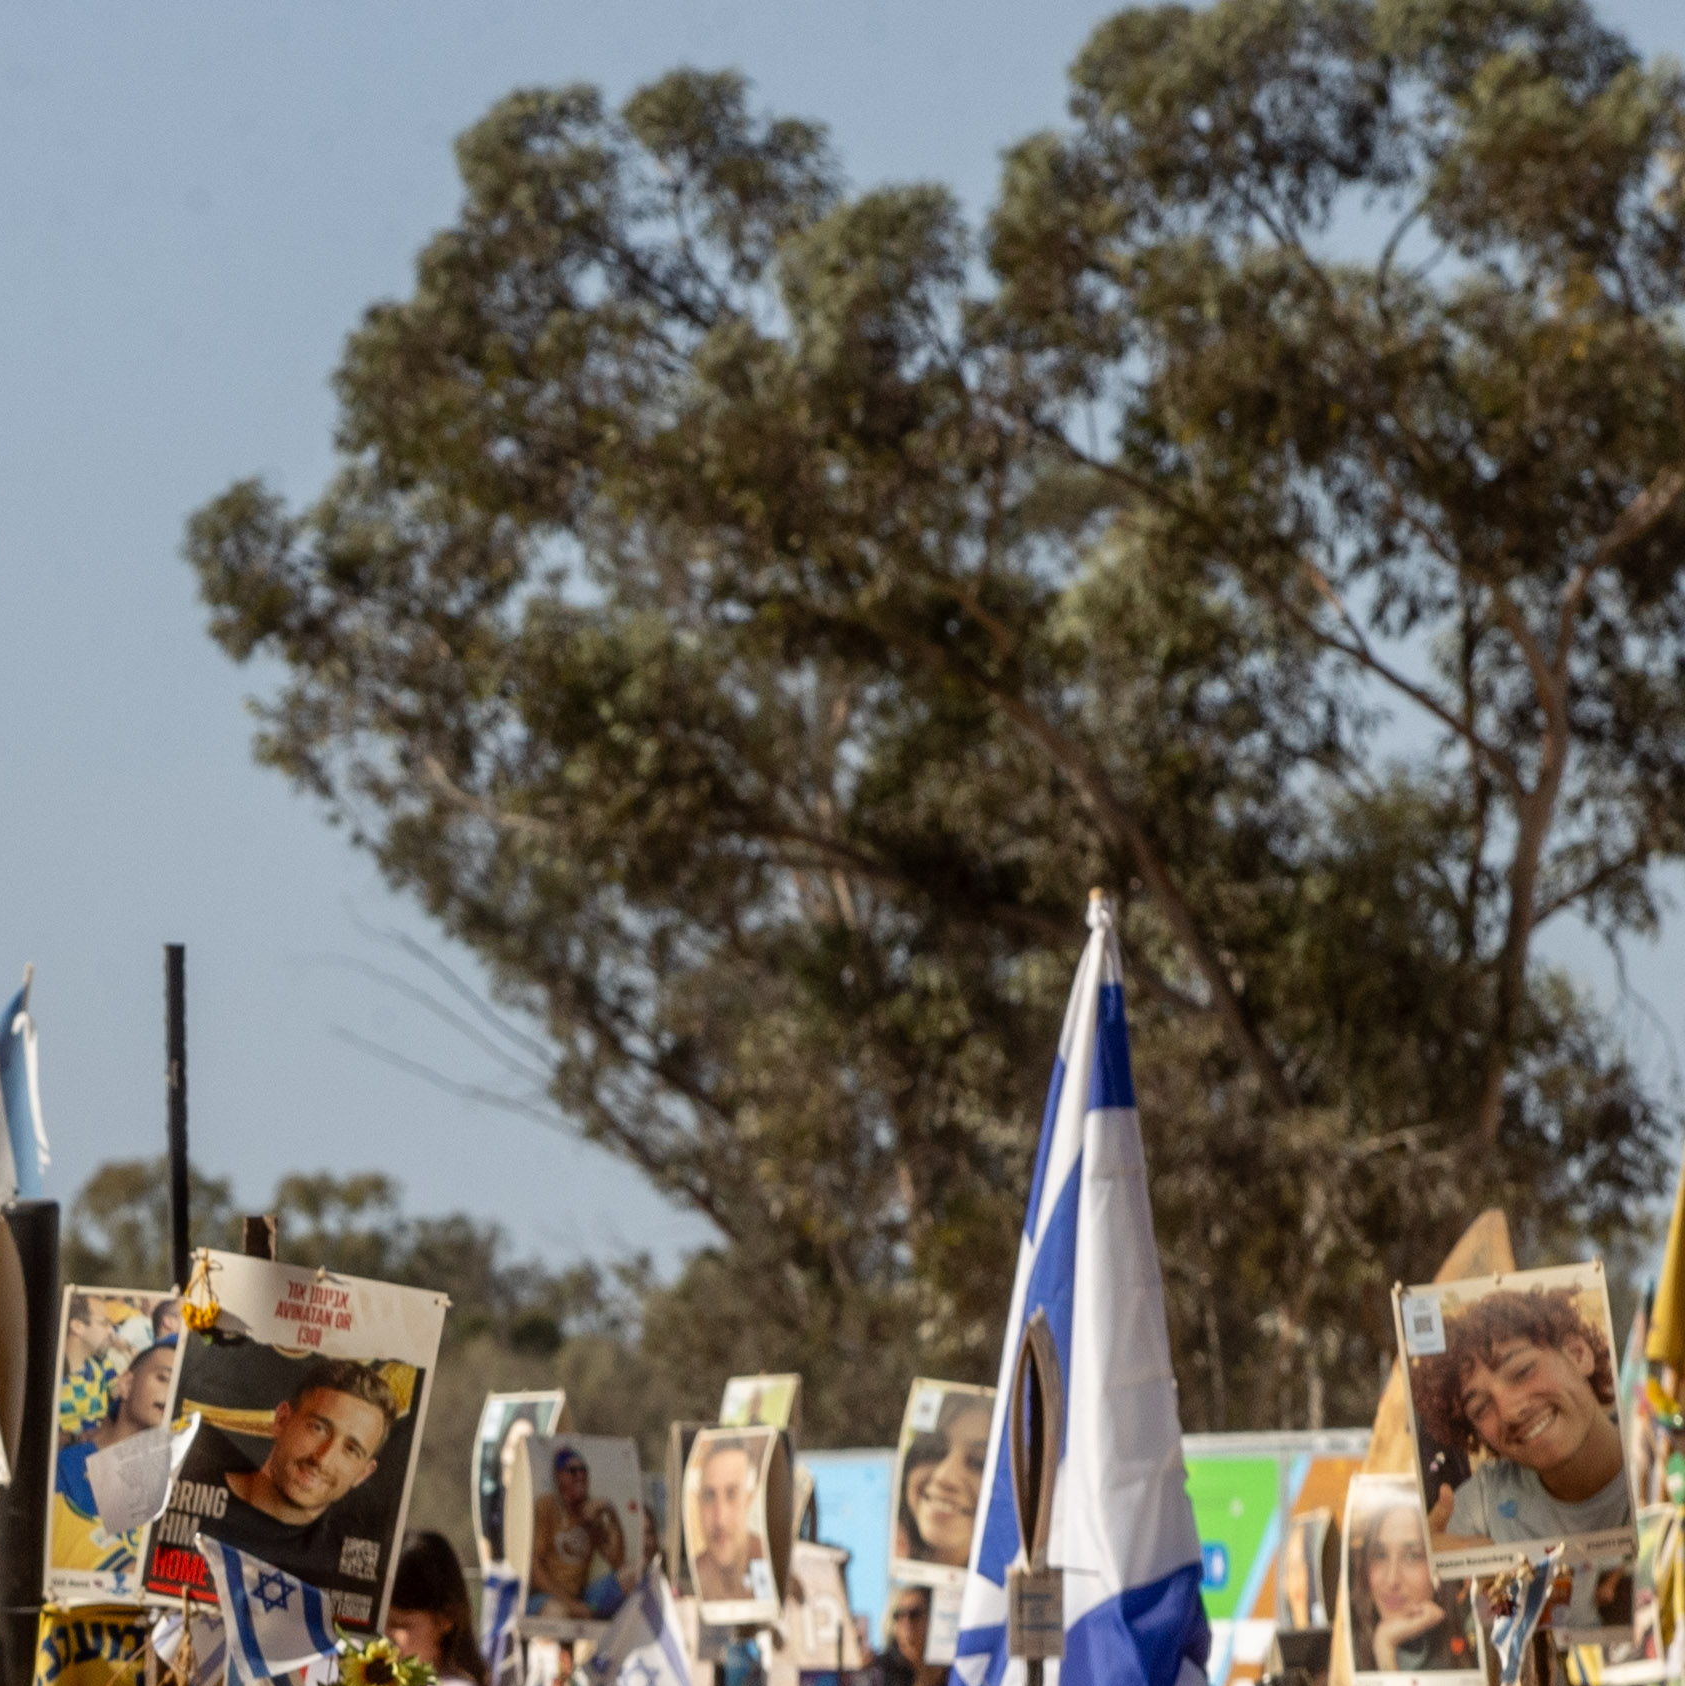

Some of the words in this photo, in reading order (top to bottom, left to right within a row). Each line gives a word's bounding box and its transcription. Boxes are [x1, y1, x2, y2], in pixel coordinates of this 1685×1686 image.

[274, 1300, 333, 1327] AVINATAN
[334, 1311, 352, 1331] OR
[168, 1480, 228, 1519] BRING
[158, 1511, 200, 1547] HIM
[152, 1546, 209, 1587] HOME
